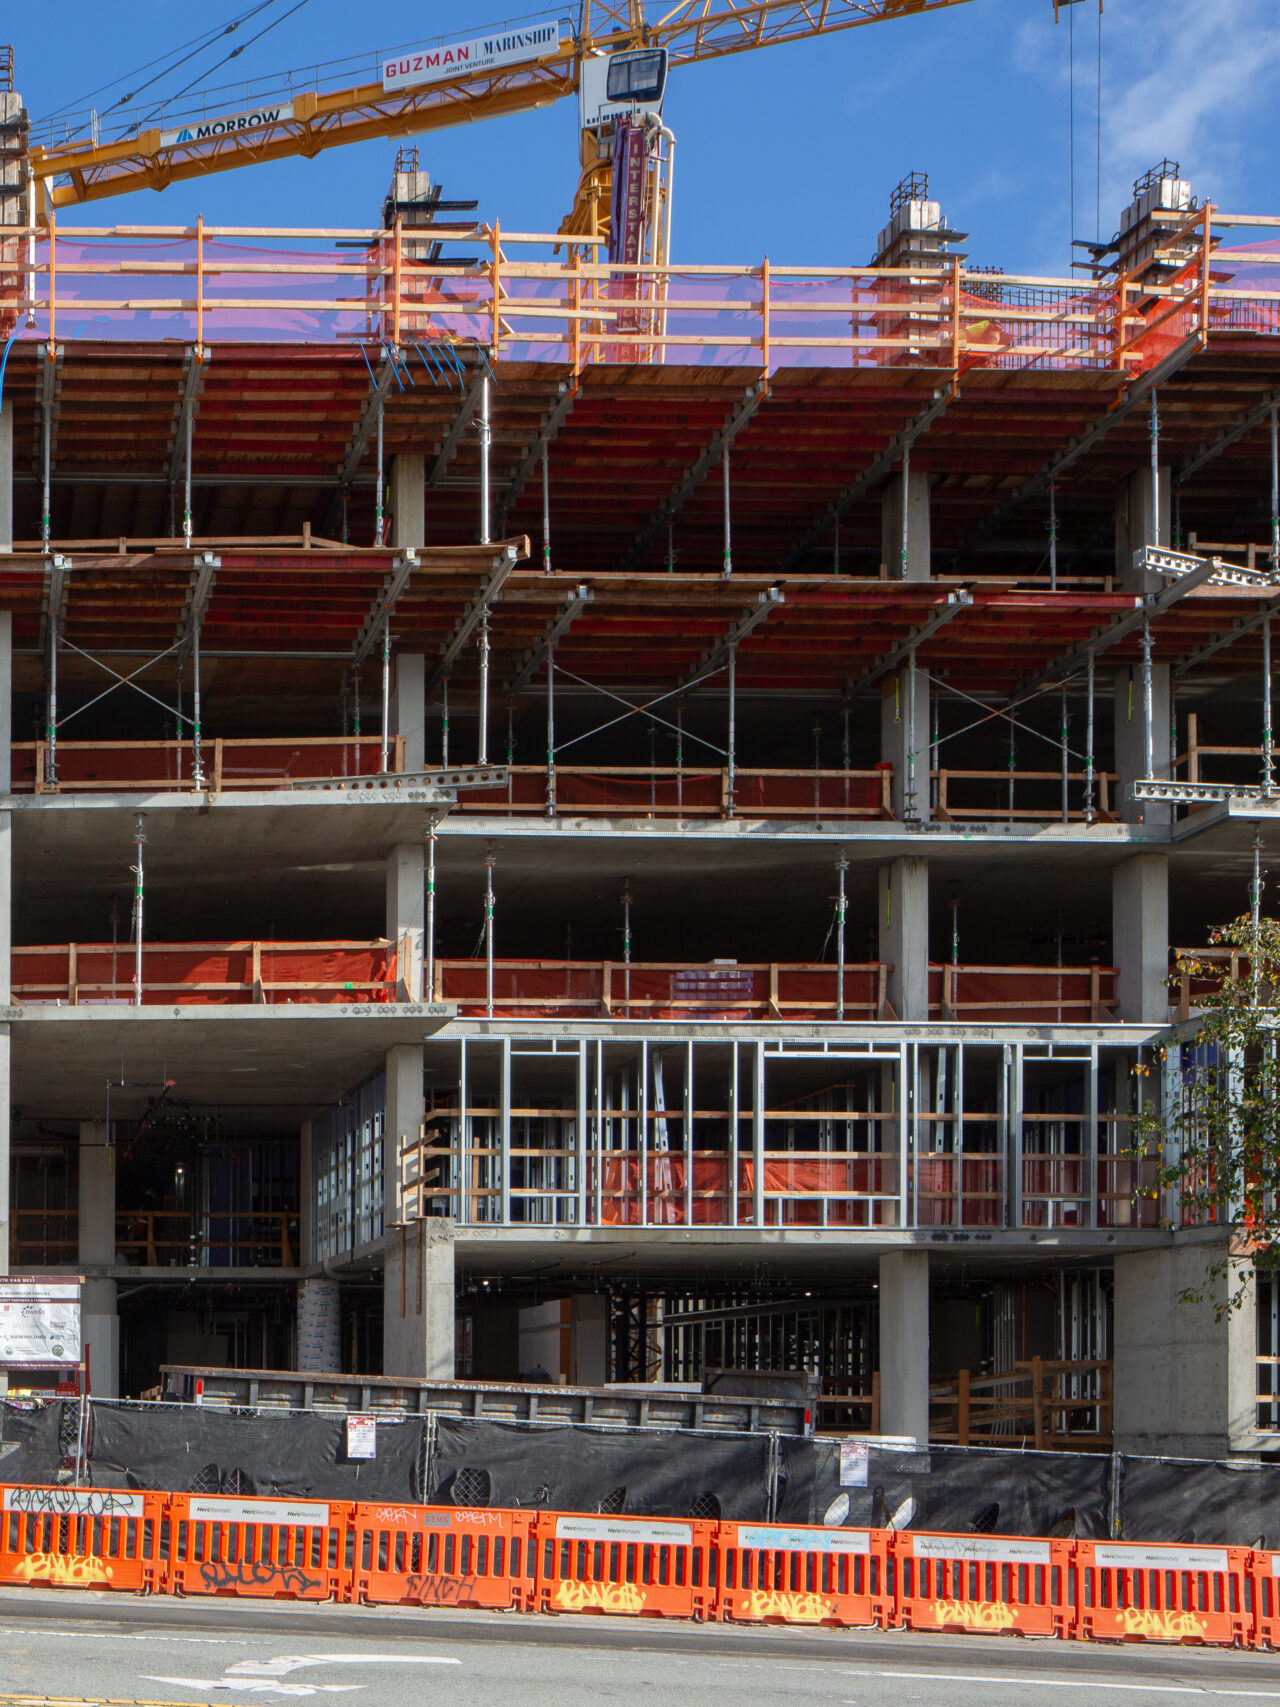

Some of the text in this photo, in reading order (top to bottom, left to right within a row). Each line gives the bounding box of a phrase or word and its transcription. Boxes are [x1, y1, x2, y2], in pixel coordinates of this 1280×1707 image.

[385, 27, 556, 78] GUZMAN MARINSHIP
[444, 57, 495, 74] JOINT VENTURE
[196, 110, 280, 138] MORROW
[624, 143, 641, 265] INTERSTAT
